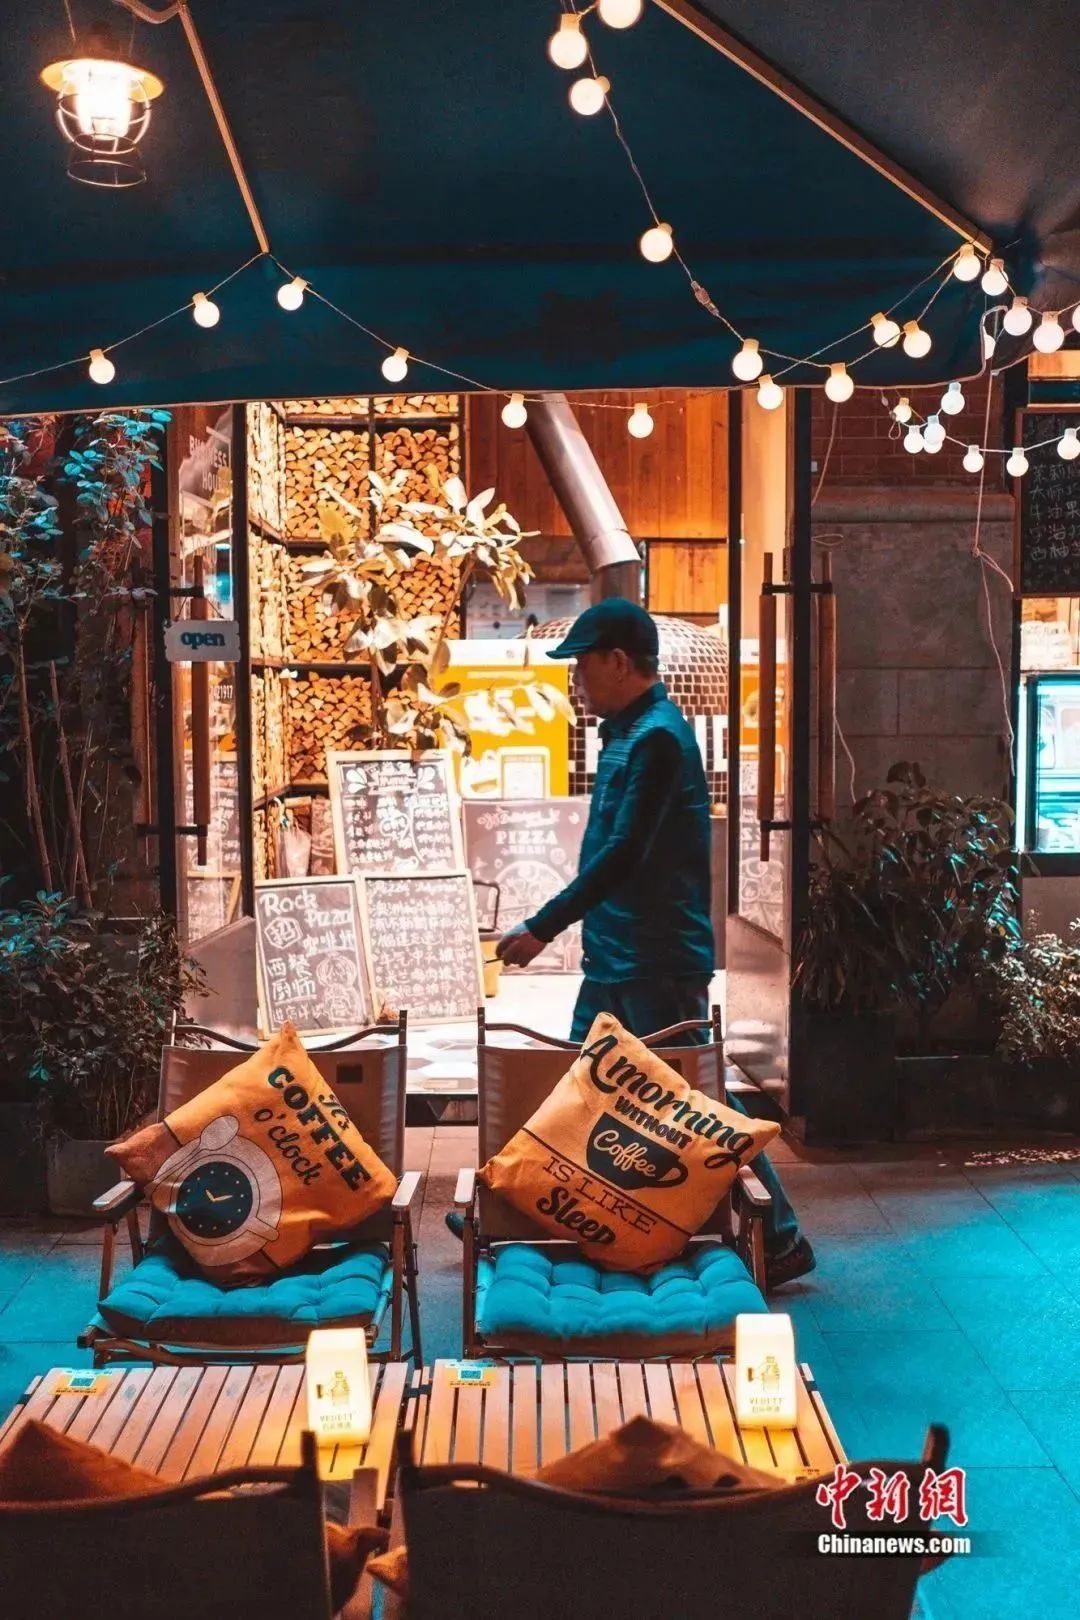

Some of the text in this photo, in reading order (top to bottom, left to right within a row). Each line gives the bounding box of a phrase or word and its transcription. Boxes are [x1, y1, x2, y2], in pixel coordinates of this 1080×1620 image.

[181, 632, 226, 650] open
[496, 829, 559, 845] PIZZA
[259, 888, 319, 917] Rock
[270, 919, 297, 946] 招
[303, 929, 354, 957] 咖啡师
[267, 953, 313, 979] 西餐
[272, 977, 317, 1001] 厨师
[580, 1034, 755, 1171] A morning
[267, 1065, 372, 1192] COFFEE
[615, 1095, 693, 1150] WITHOUT
[254, 1107, 323, 1187] o'clock
[593, 1129, 657, 1178] Coffee
[542, 1156, 658, 1235] IS LIKE
[536, 1185, 617, 1246] Sleep
